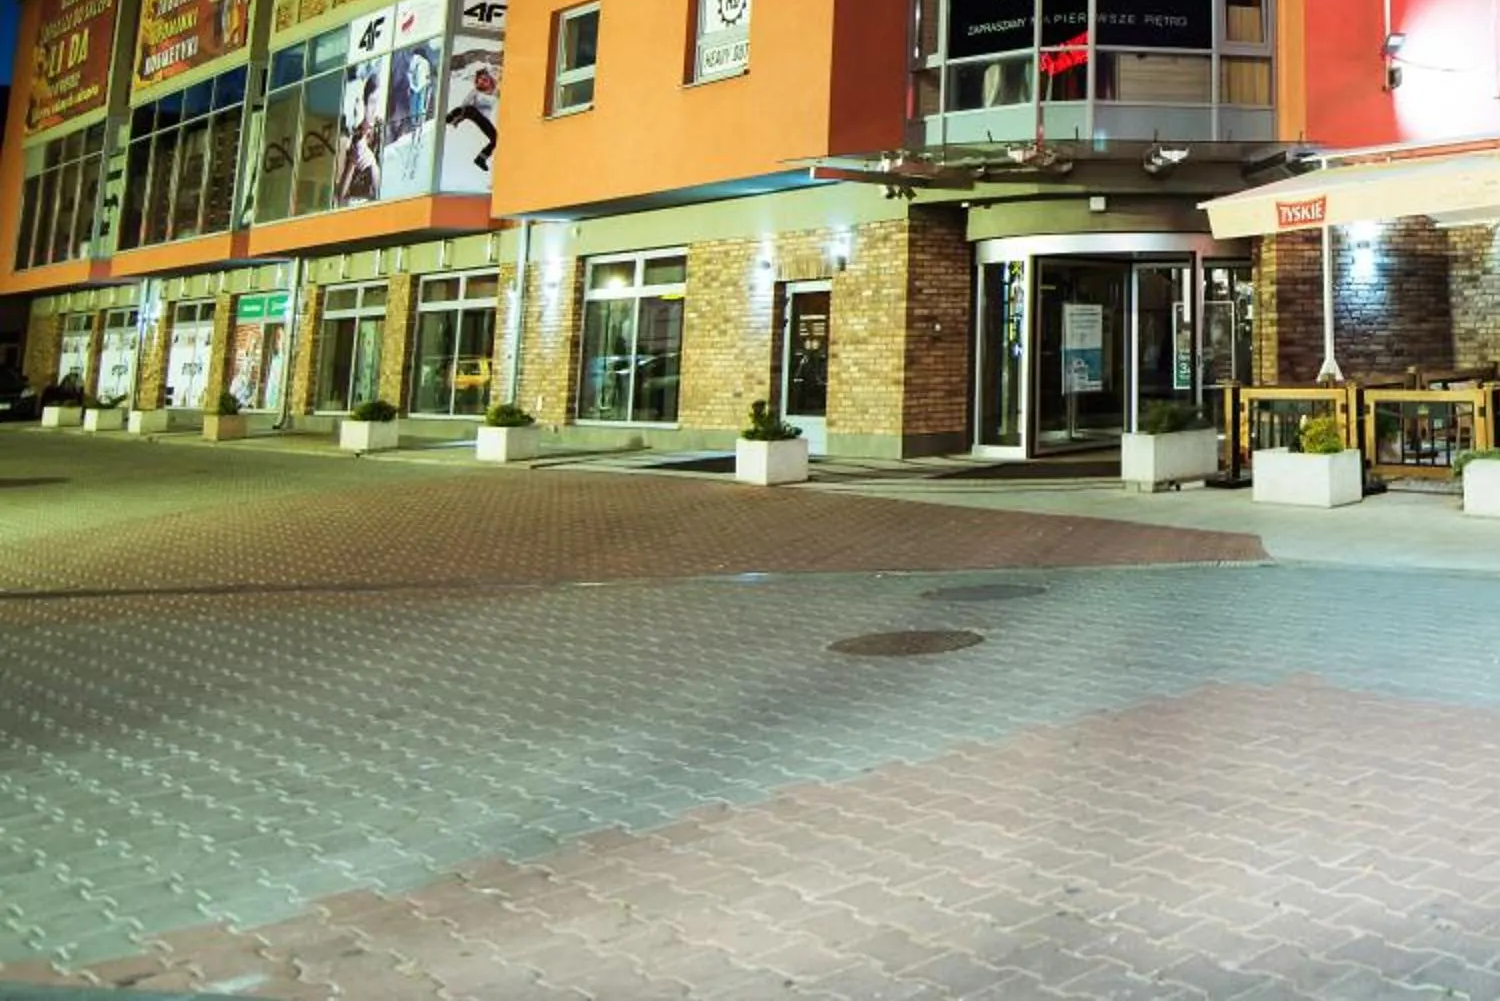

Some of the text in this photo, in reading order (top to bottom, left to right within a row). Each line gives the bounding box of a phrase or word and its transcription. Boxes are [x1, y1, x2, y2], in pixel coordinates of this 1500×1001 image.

[463, 2, 508, 23] 4F
[358, 16, 386, 51] 4F
[1279, 202, 1323, 224] TYSKIE
